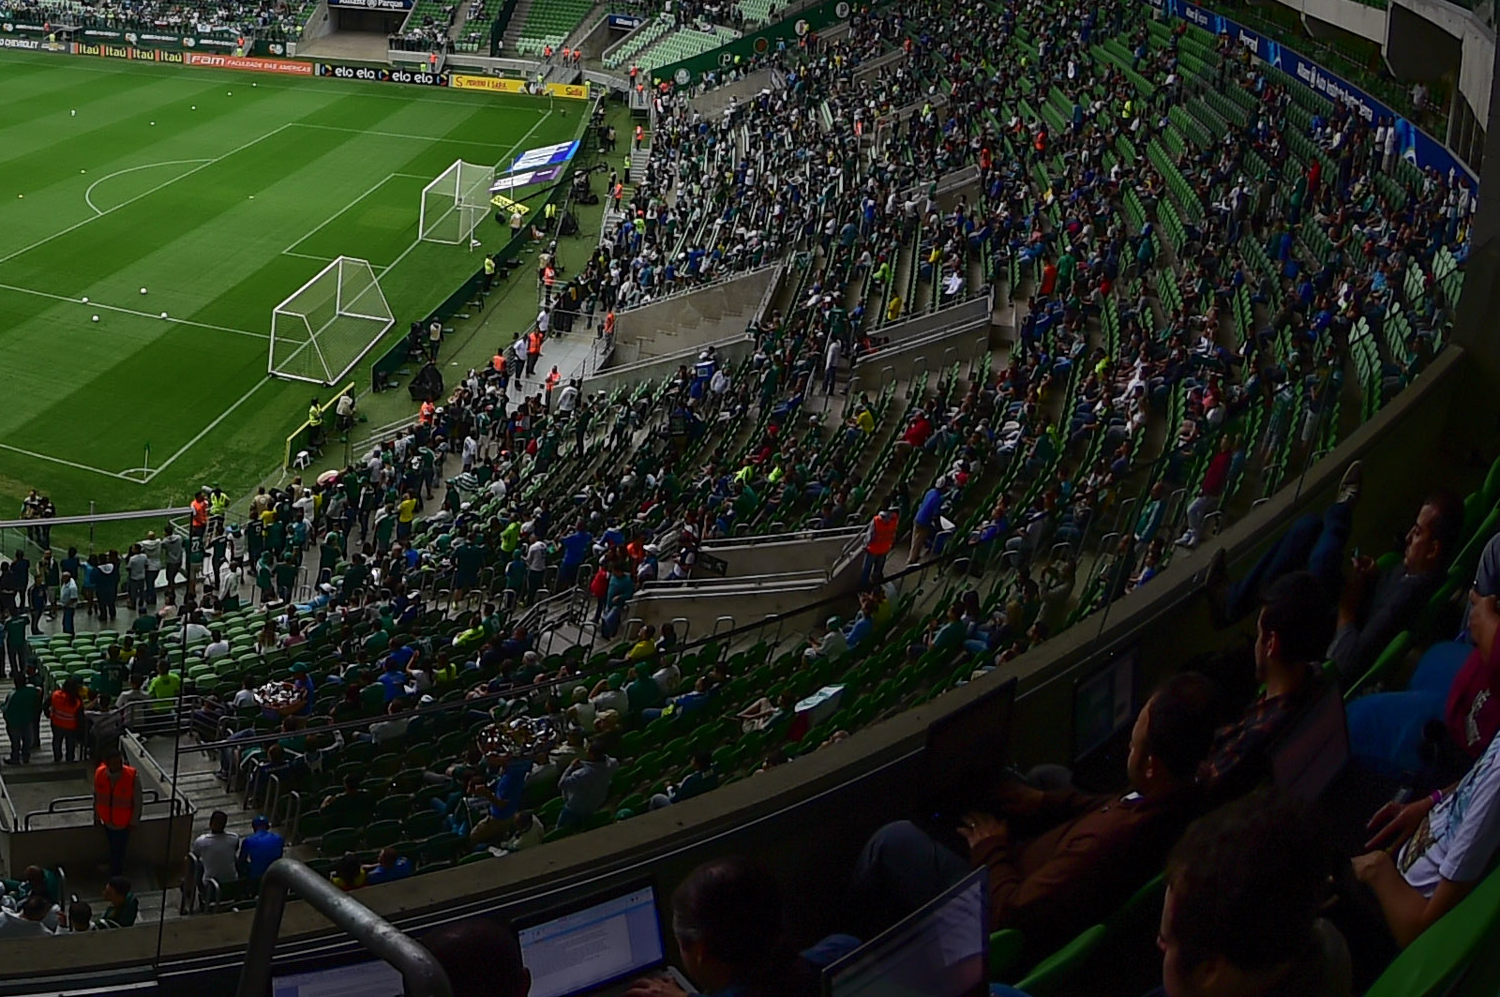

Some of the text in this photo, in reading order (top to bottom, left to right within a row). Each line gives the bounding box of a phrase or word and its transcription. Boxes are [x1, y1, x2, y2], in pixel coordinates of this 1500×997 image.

[79, 44, 100, 55] Itaú
[105, 46, 127, 58] Itaú
[133, 49, 155, 61] Itaú
[160, 52, 183, 63] Itaú
[334, 67, 354, 78] elo
[356, 69, 375, 79] elo
[392, 71, 411, 82] elo
[414, 72, 433, 84] elo
